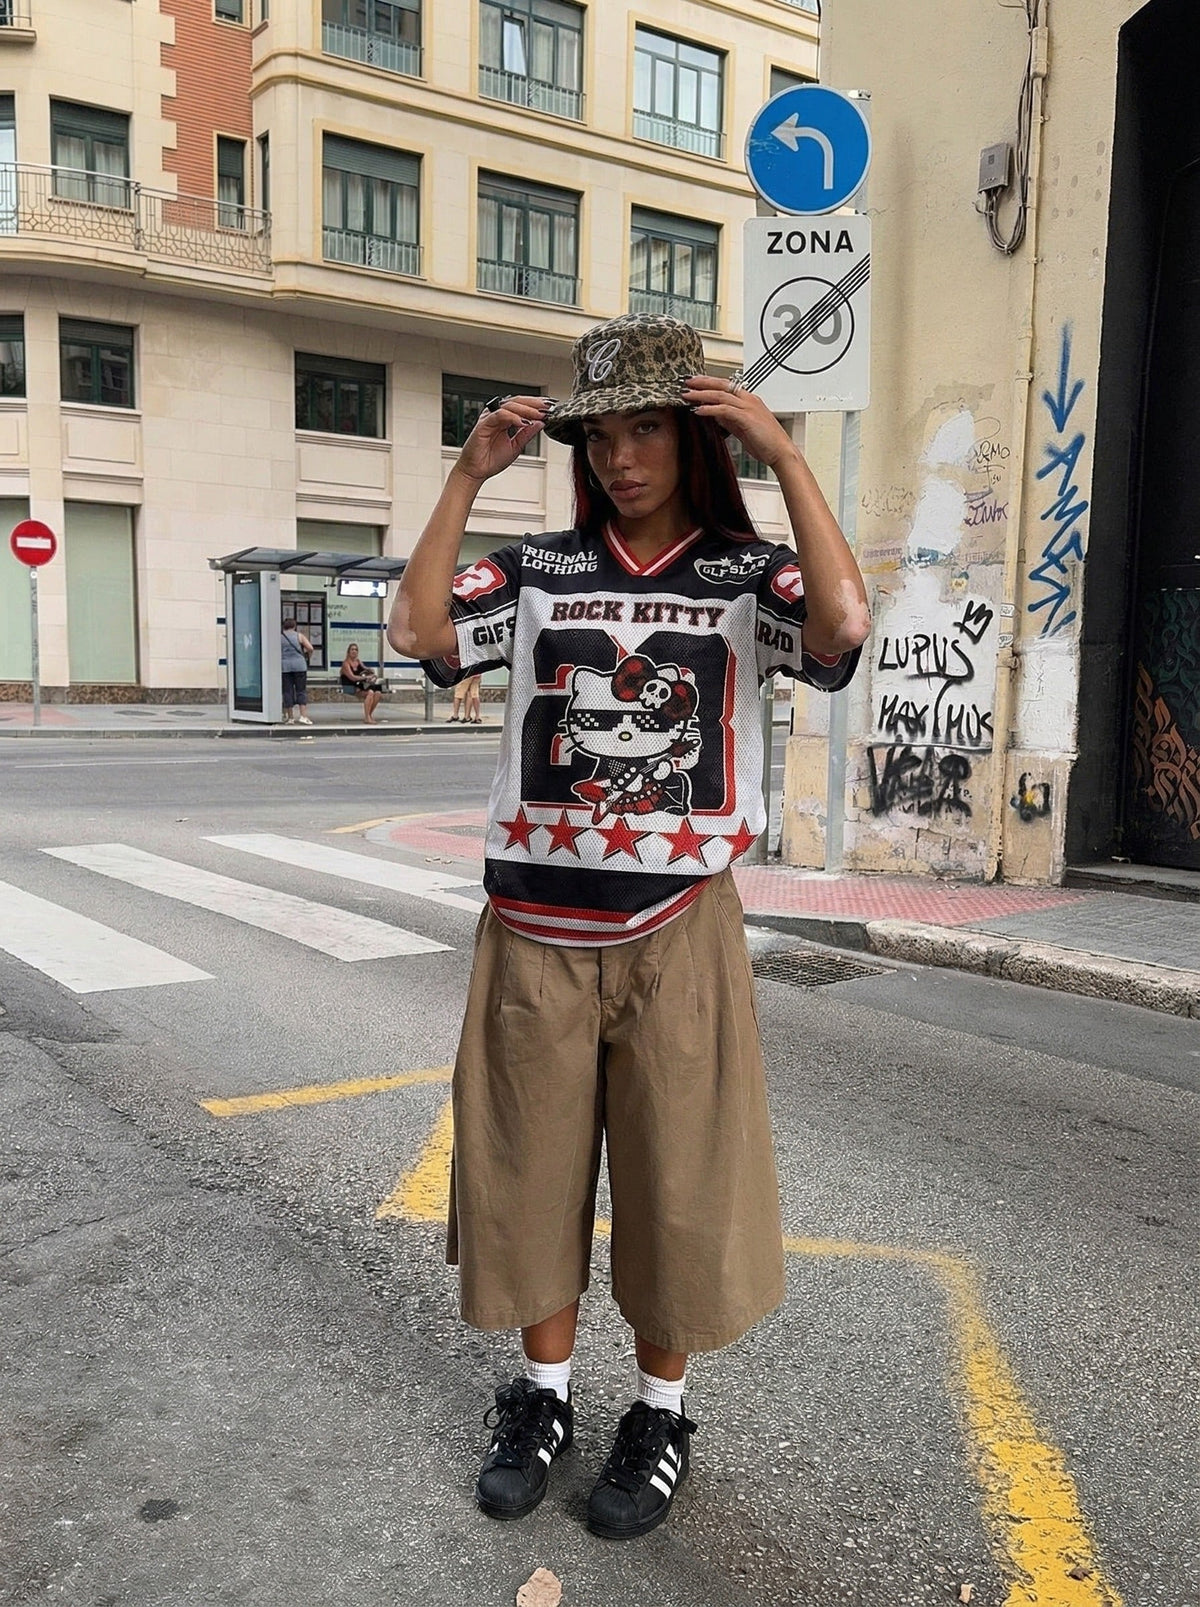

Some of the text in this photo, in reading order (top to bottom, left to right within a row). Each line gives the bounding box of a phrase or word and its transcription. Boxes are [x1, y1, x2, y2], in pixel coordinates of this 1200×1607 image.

[767, 230, 853, 254] ZONA
[773, 304, 842, 345] 30
[521, 544, 598, 565] RIGINAL
[521, 556, 598, 575] LOTHING
[550, 600, 725, 628] ROCK KITTY
[878, 633, 975, 685] LUPUS
